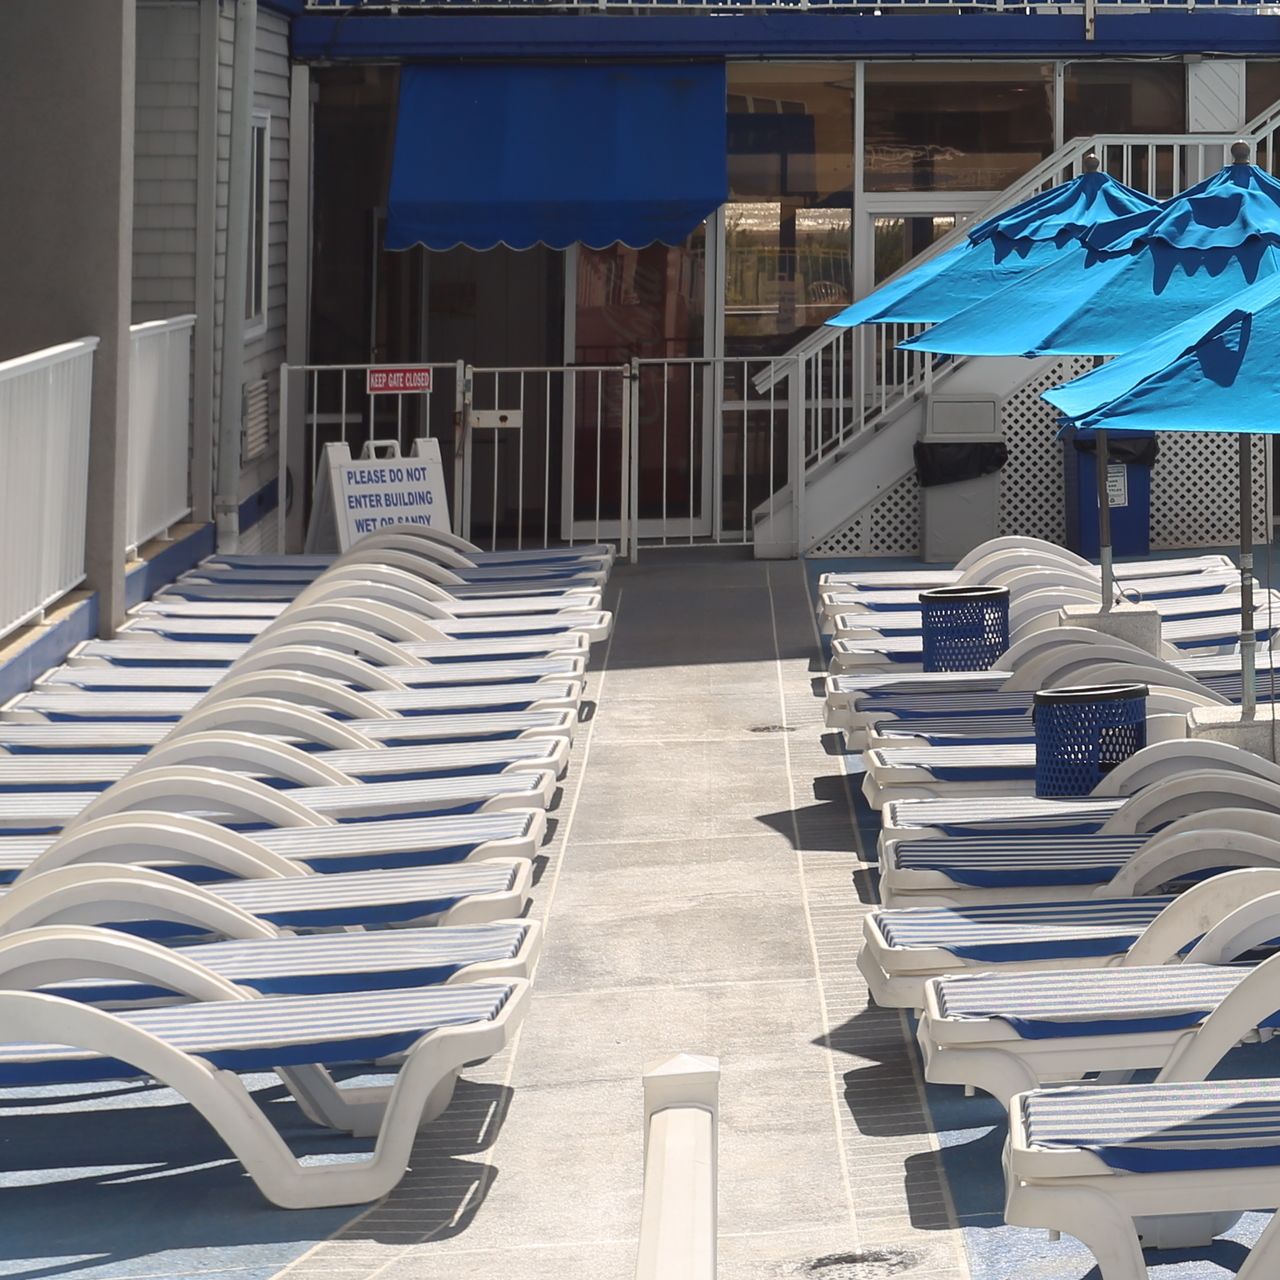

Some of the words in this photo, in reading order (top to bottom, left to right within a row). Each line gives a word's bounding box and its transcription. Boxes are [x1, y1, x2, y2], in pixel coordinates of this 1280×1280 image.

[370, 373, 387, 388] KEEP
[388, 372, 404, 388] GATE
[405, 372, 430, 387] CLOSED
[347, 469, 387, 486] PLEASE
[389, 468, 404, 483] DO
[406, 466, 427, 482] NOT
[347, 493, 383, 510] ENTER
[384, 490, 433, 508] BUILDING
[355, 518, 377, 533] WET
